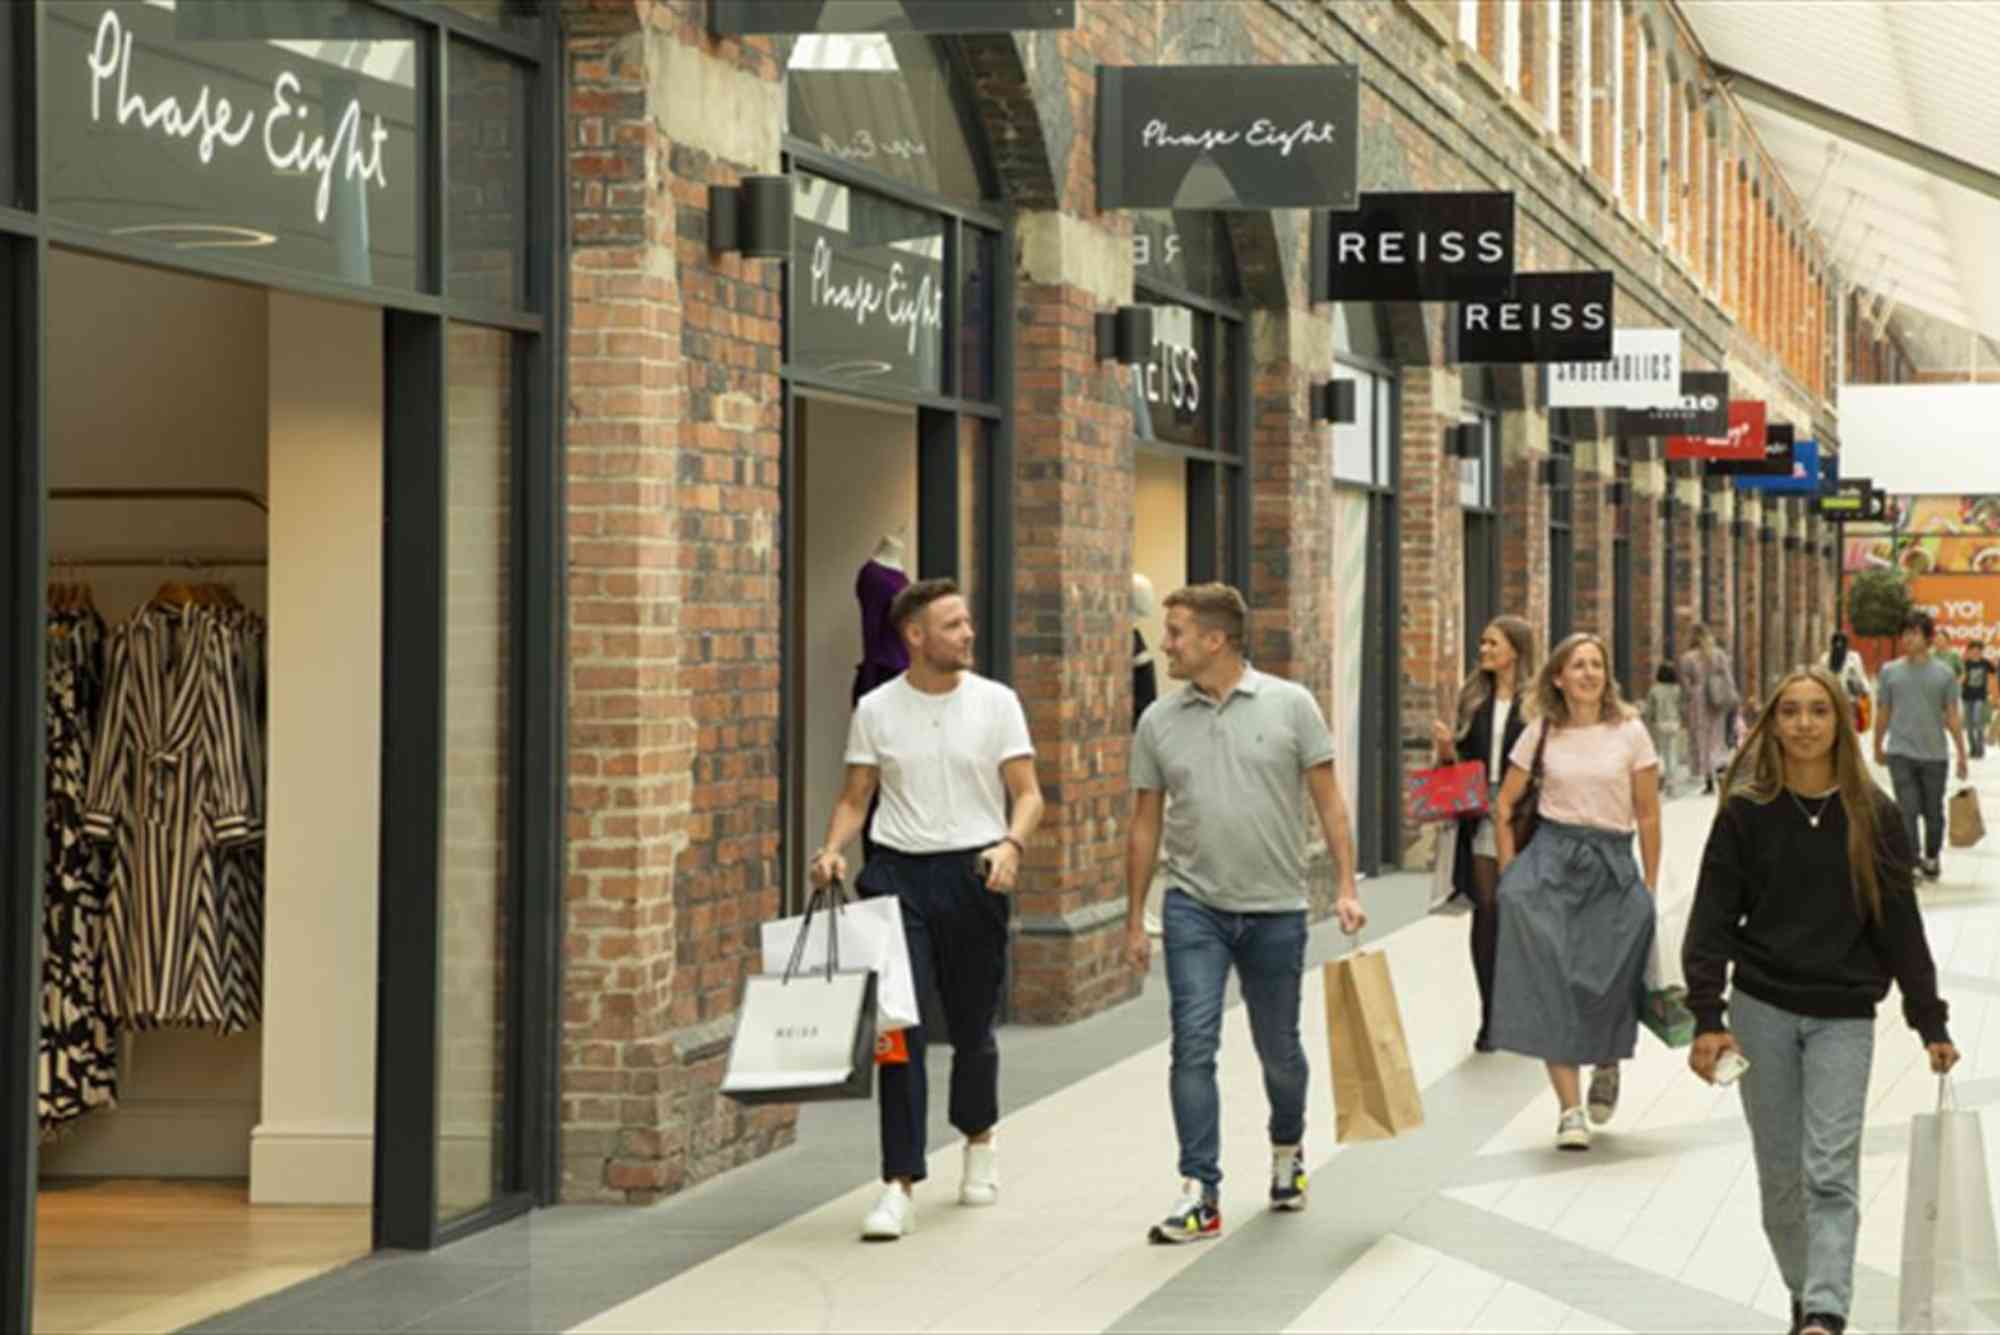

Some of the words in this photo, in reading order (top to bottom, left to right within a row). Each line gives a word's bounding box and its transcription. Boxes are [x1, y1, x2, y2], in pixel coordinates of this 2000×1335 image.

[88, 9, 254, 164] Phase
[263, 71, 388, 224] Eight
[1141, 118, 1240, 150] Phase
[1245, 118, 1336, 157] Eight
[1337, 230, 1504, 264] REISS
[810, 235, 882, 325] Phase
[1465, 302, 1605, 331] REISS
